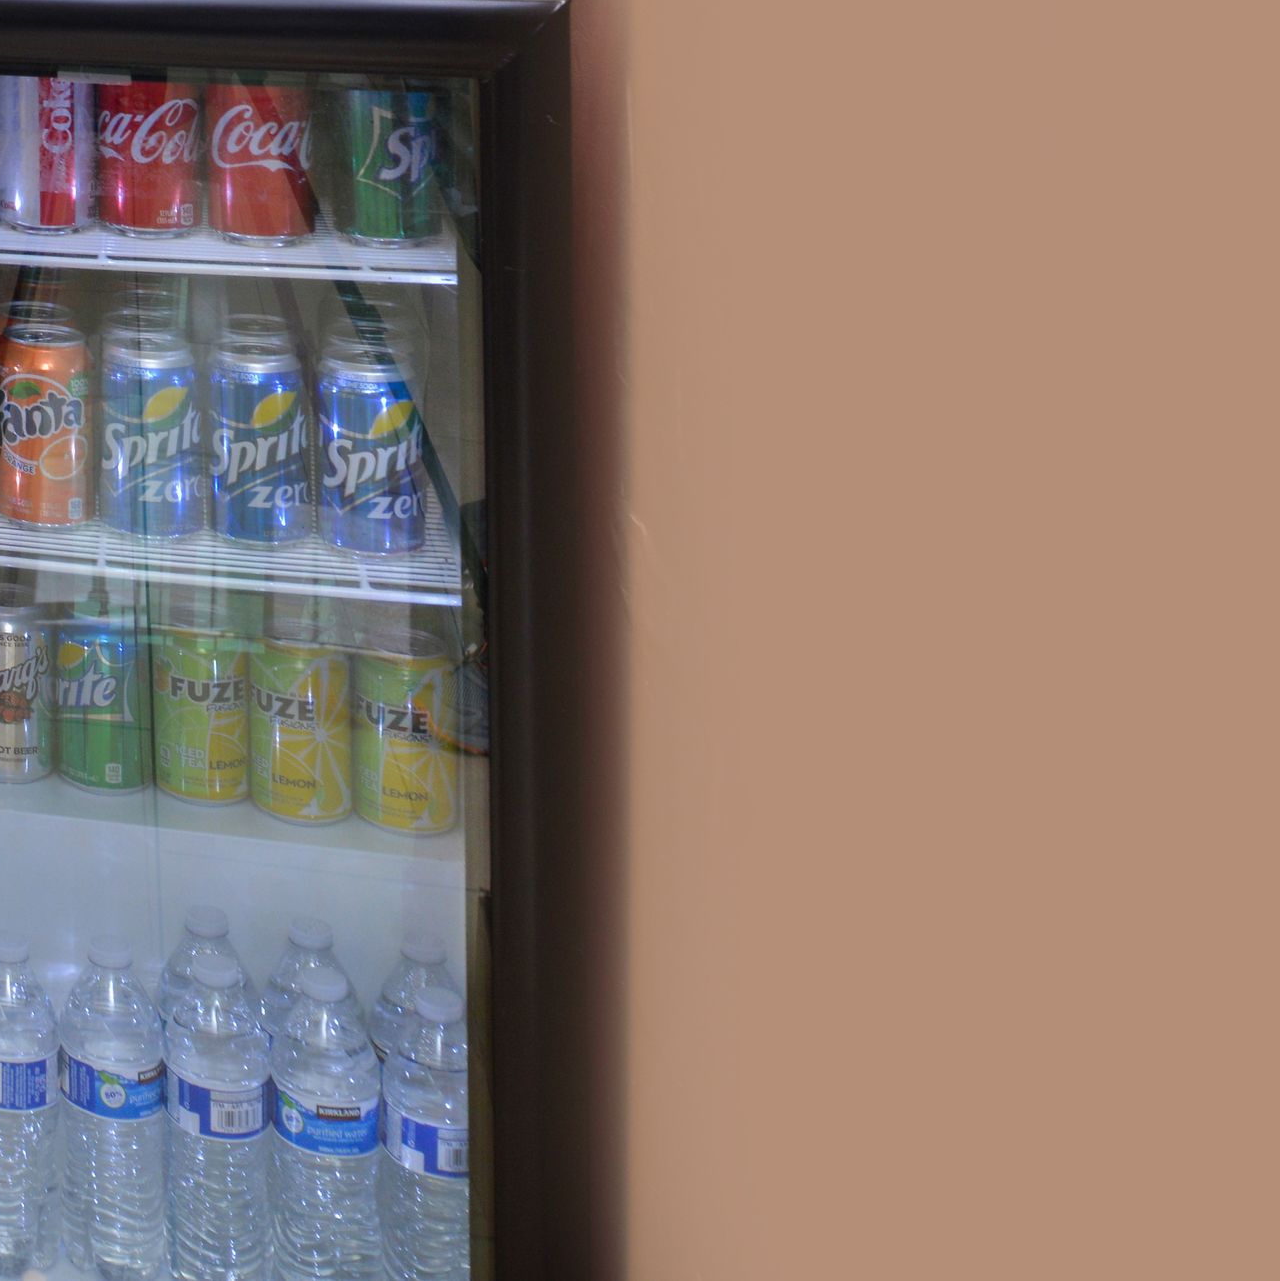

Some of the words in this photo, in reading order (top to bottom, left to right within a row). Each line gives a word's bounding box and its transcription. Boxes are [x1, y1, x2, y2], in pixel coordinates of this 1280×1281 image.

[170, 676, 245, 705] FUZE
[13, 745, 39, 756] BEER
[272, 772, 318, 790] LEMON
[382, 786, 430, 803] LEMON
